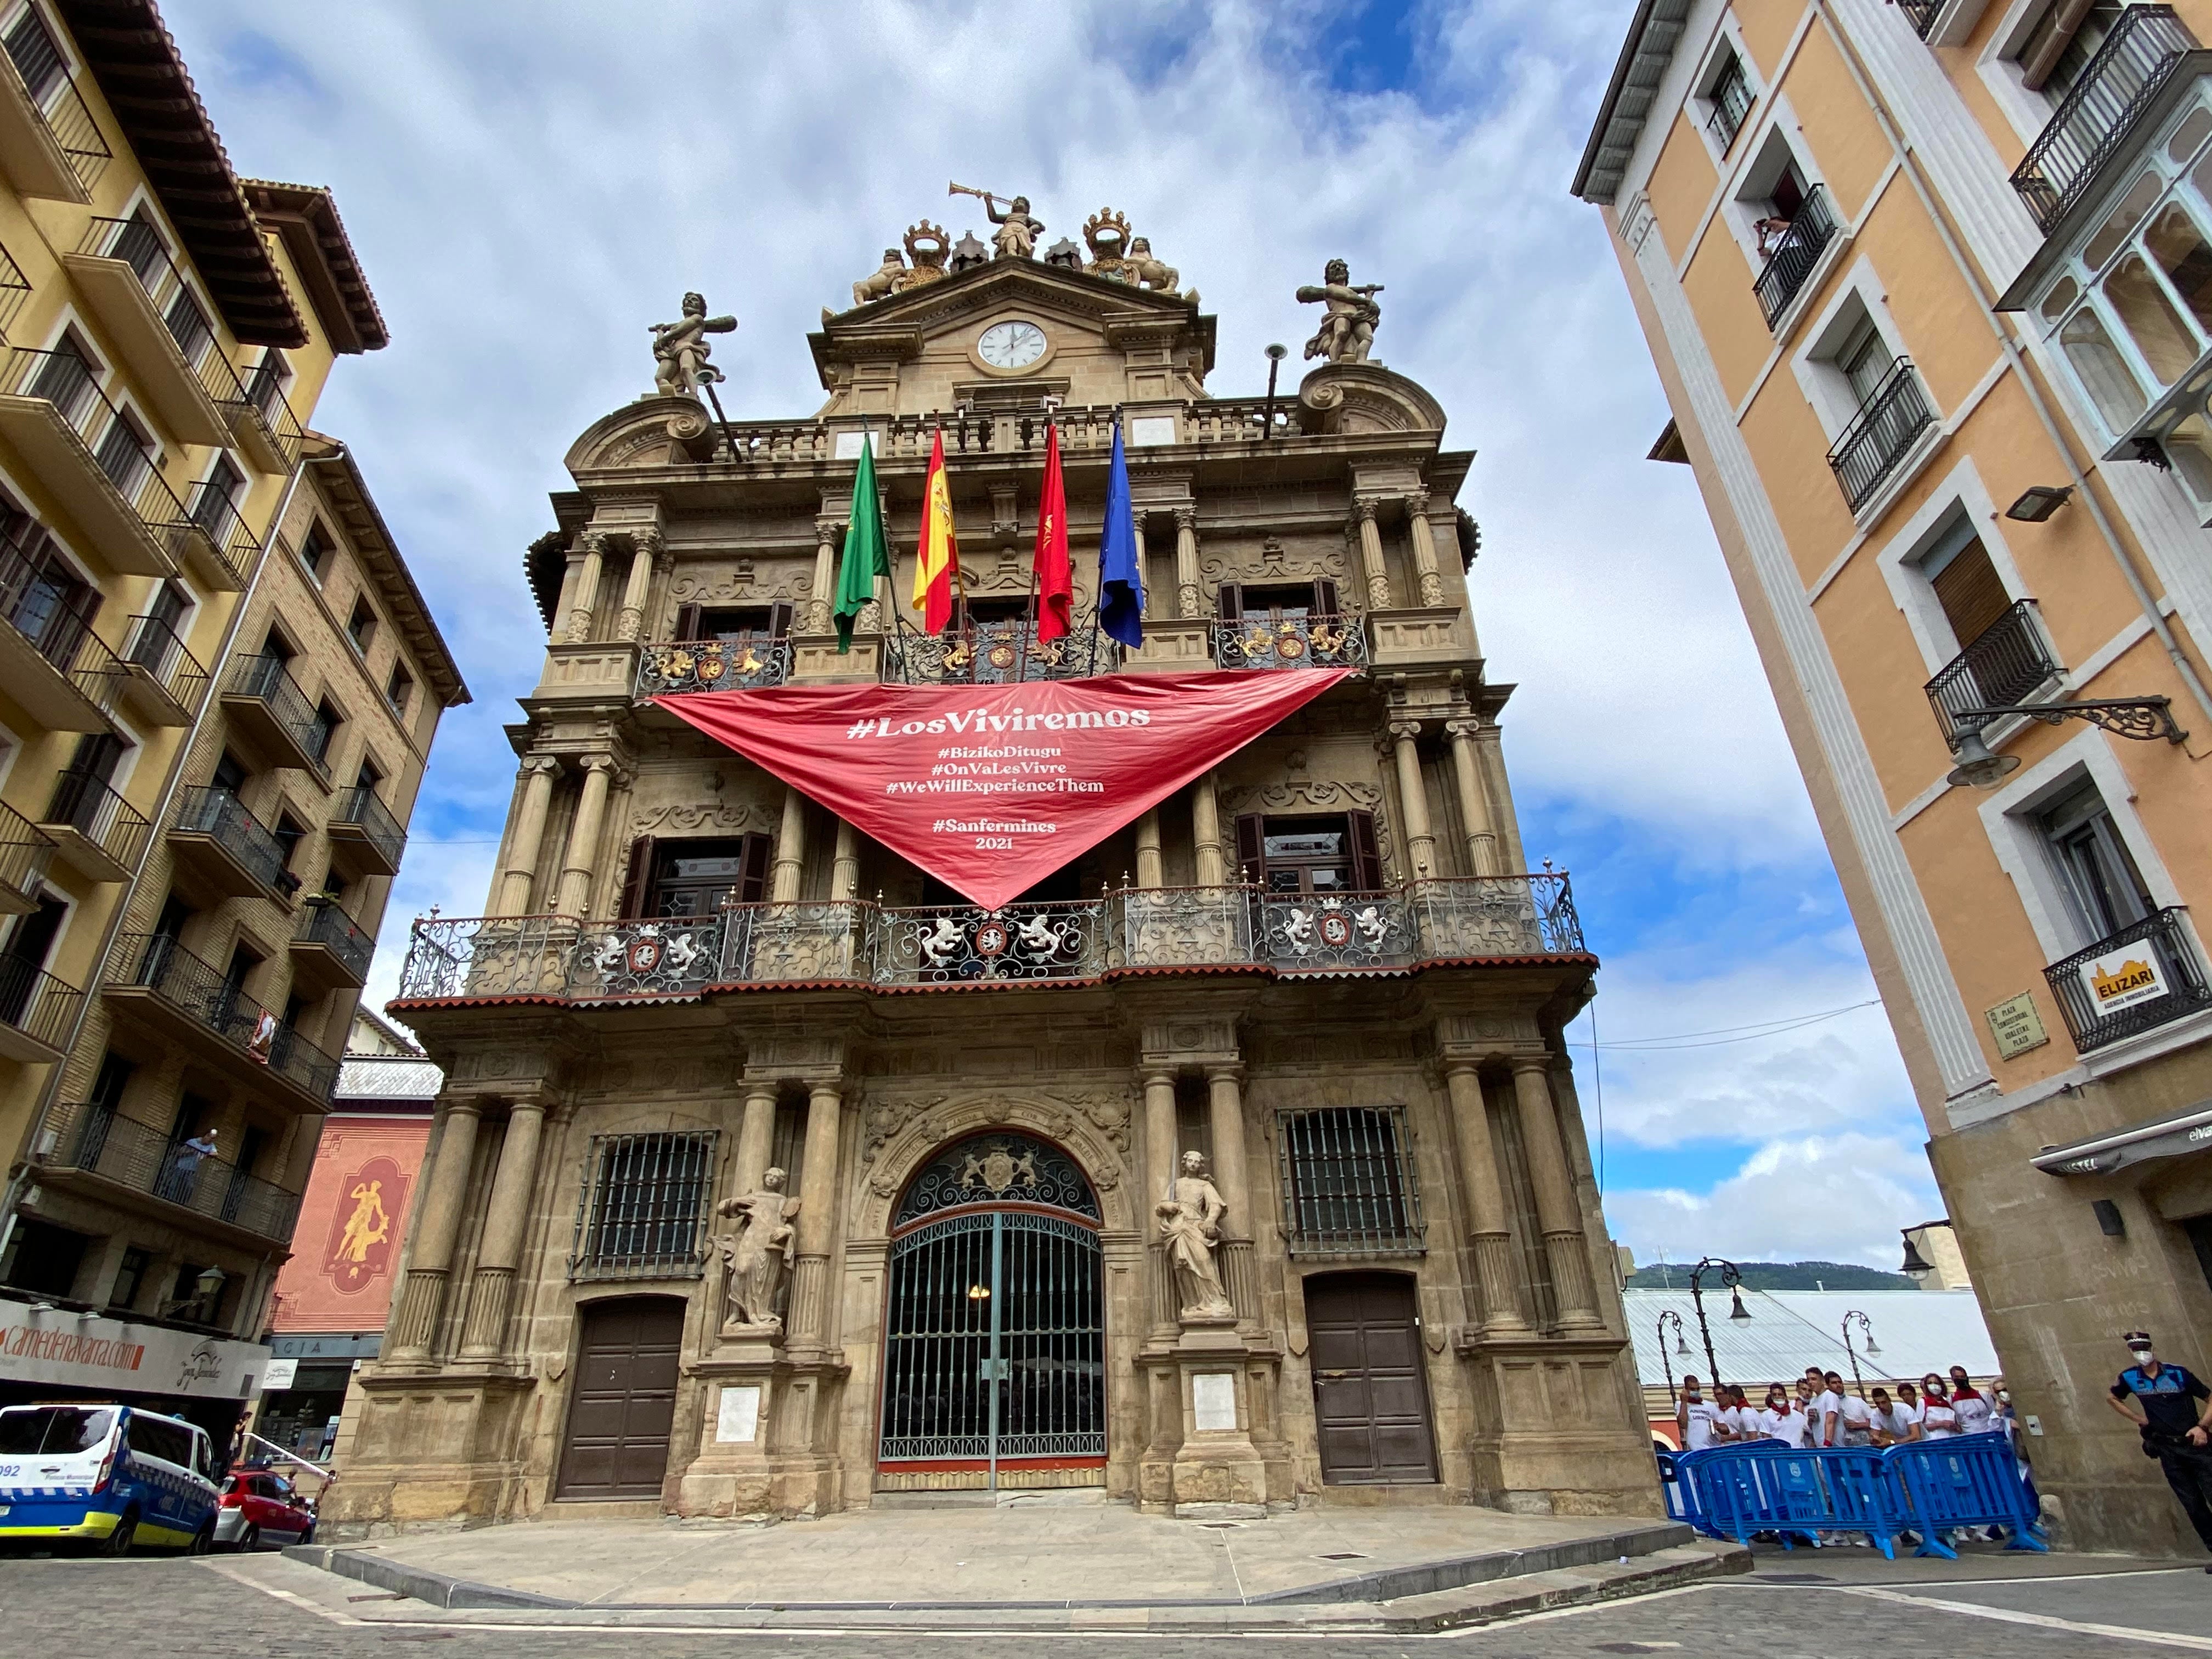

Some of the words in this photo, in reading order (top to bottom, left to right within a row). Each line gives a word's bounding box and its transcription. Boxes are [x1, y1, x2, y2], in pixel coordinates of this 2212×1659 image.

[847, 708, 1151, 739] #LosViviremos
[938, 745, 1062, 759] #BizikoDitugu
[932, 761, 1067, 776] #OnVaLesVivre
[886, 778, 1104, 794] #WeWillExperienceThem
[933, 819, 1057, 833] #Sanfermines
[975, 837, 1013, 850] 2021
[2098, 968, 2155, 998] ELIZARI
